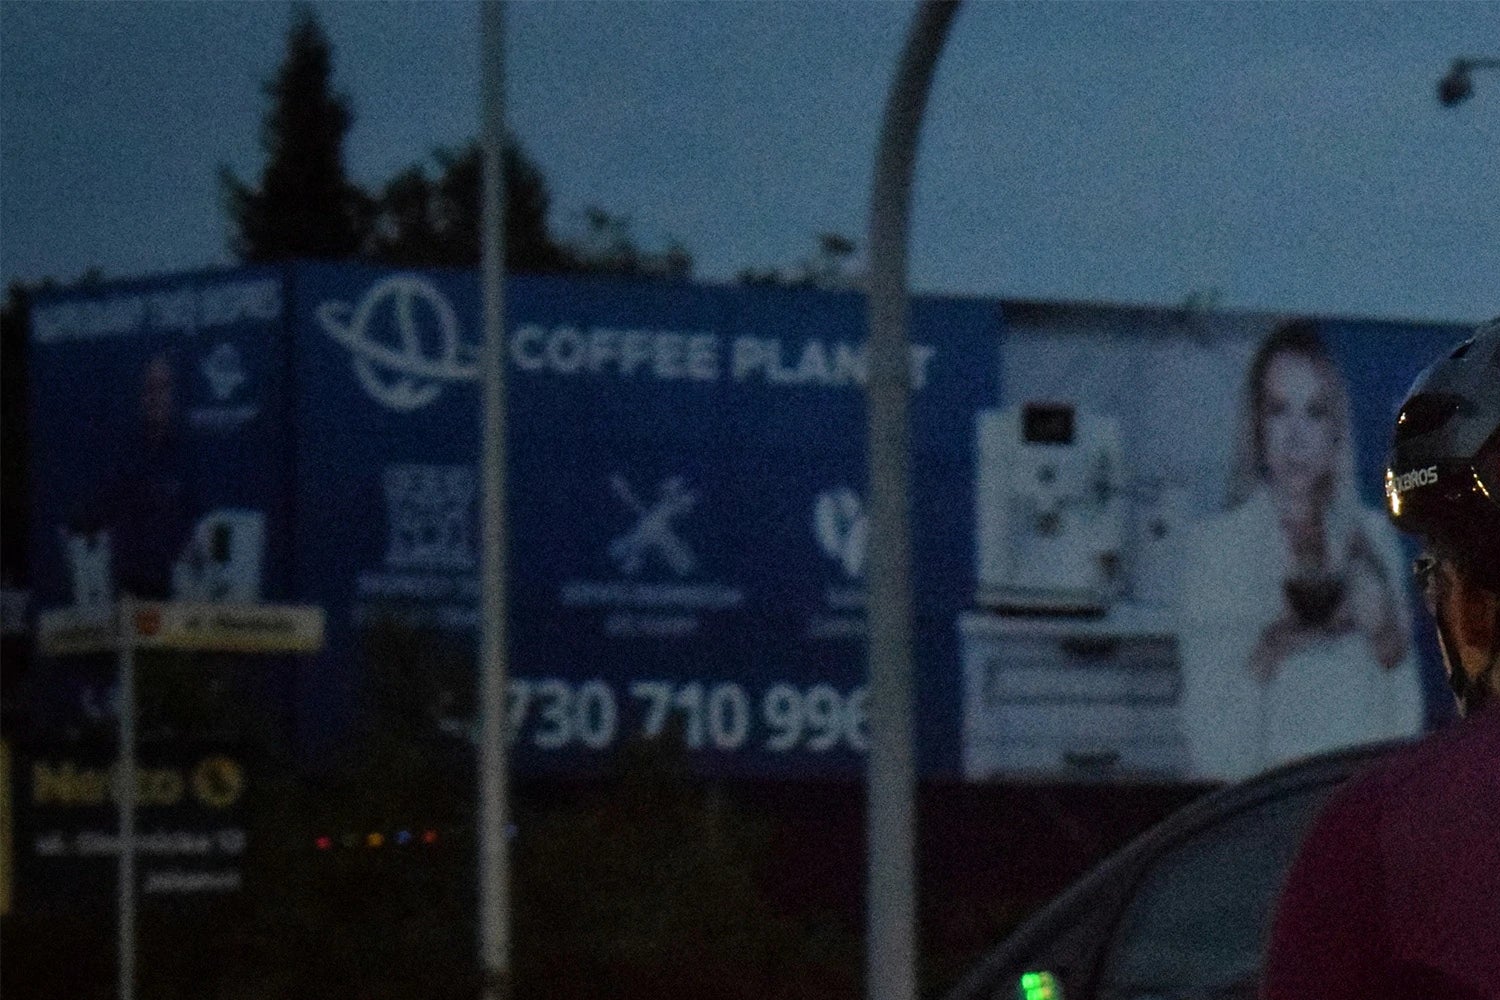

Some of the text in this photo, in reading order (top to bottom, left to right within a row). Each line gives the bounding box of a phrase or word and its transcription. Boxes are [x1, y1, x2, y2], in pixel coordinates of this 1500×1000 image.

[510, 323, 938, 391] COFFEE PLANT
[505, 678, 618, 750] 730
[628, 678, 752, 752] 710
